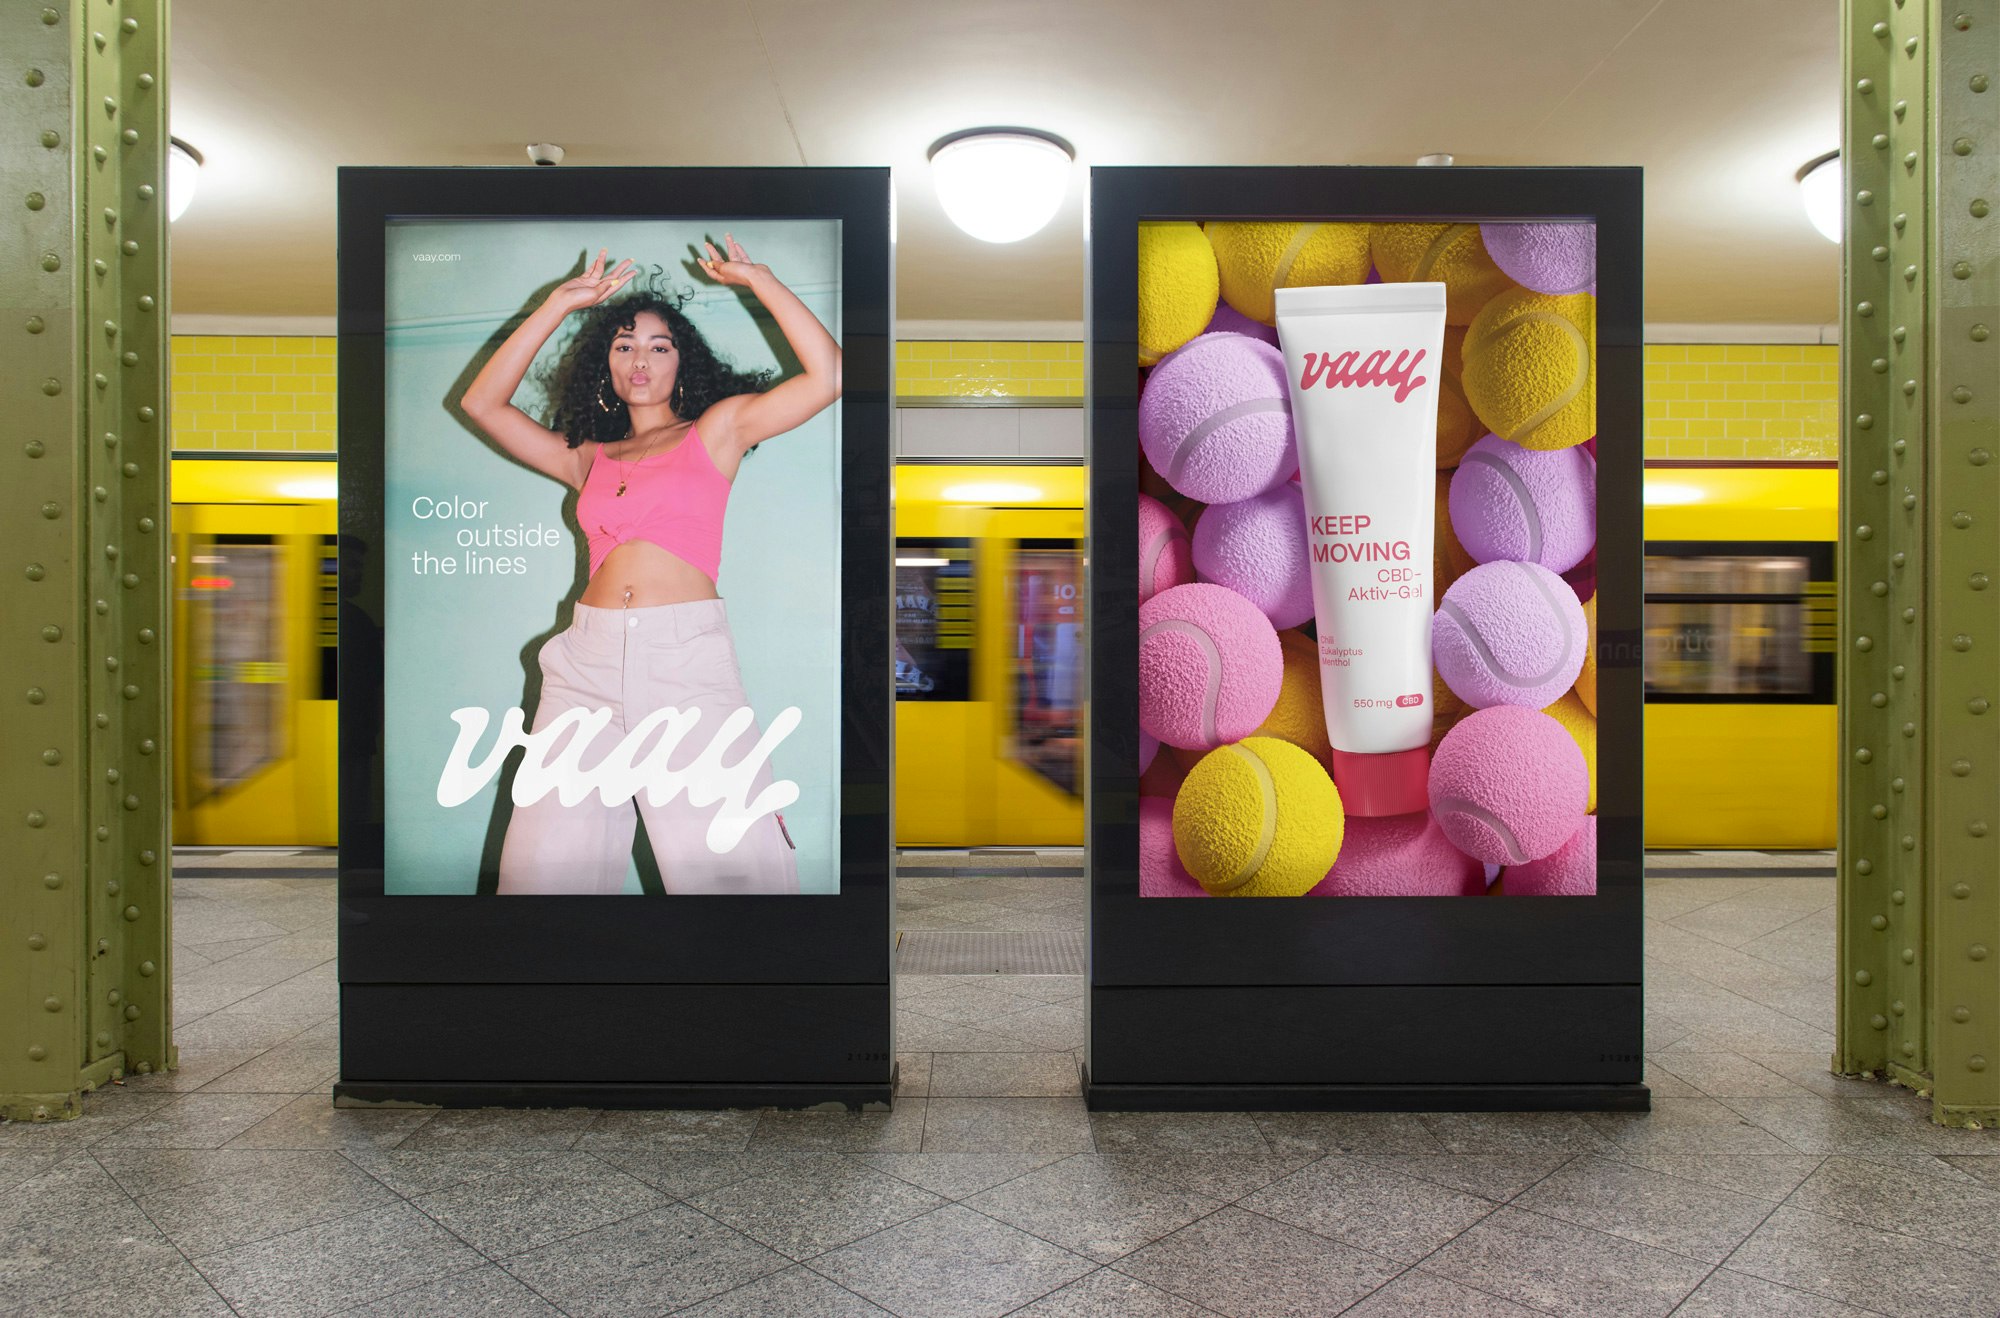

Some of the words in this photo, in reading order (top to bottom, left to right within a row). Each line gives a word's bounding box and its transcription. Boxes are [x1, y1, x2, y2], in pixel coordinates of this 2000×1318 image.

[412, 253, 461, 263] vaay.com
[1300, 349, 1427, 403] vaay
[412, 495, 489, 519] Color
[456, 522, 560, 547] outside
[1311, 515, 1371, 535] KEEP
[411, 550, 457, 575] the
[465, 550, 527, 575] lines
[1313, 541, 1411, 563] MOVING
[1348, 584, 1422, 601] Aktiv-Gel
[1321, 646, 1363, 657] Eukalyptus
[1353, 699, 1374, 708] 550
[1375, 699, 1393, 709] mg
[1402, 695, 1419, 705] CBD
[436, 706, 803, 854] vaay
